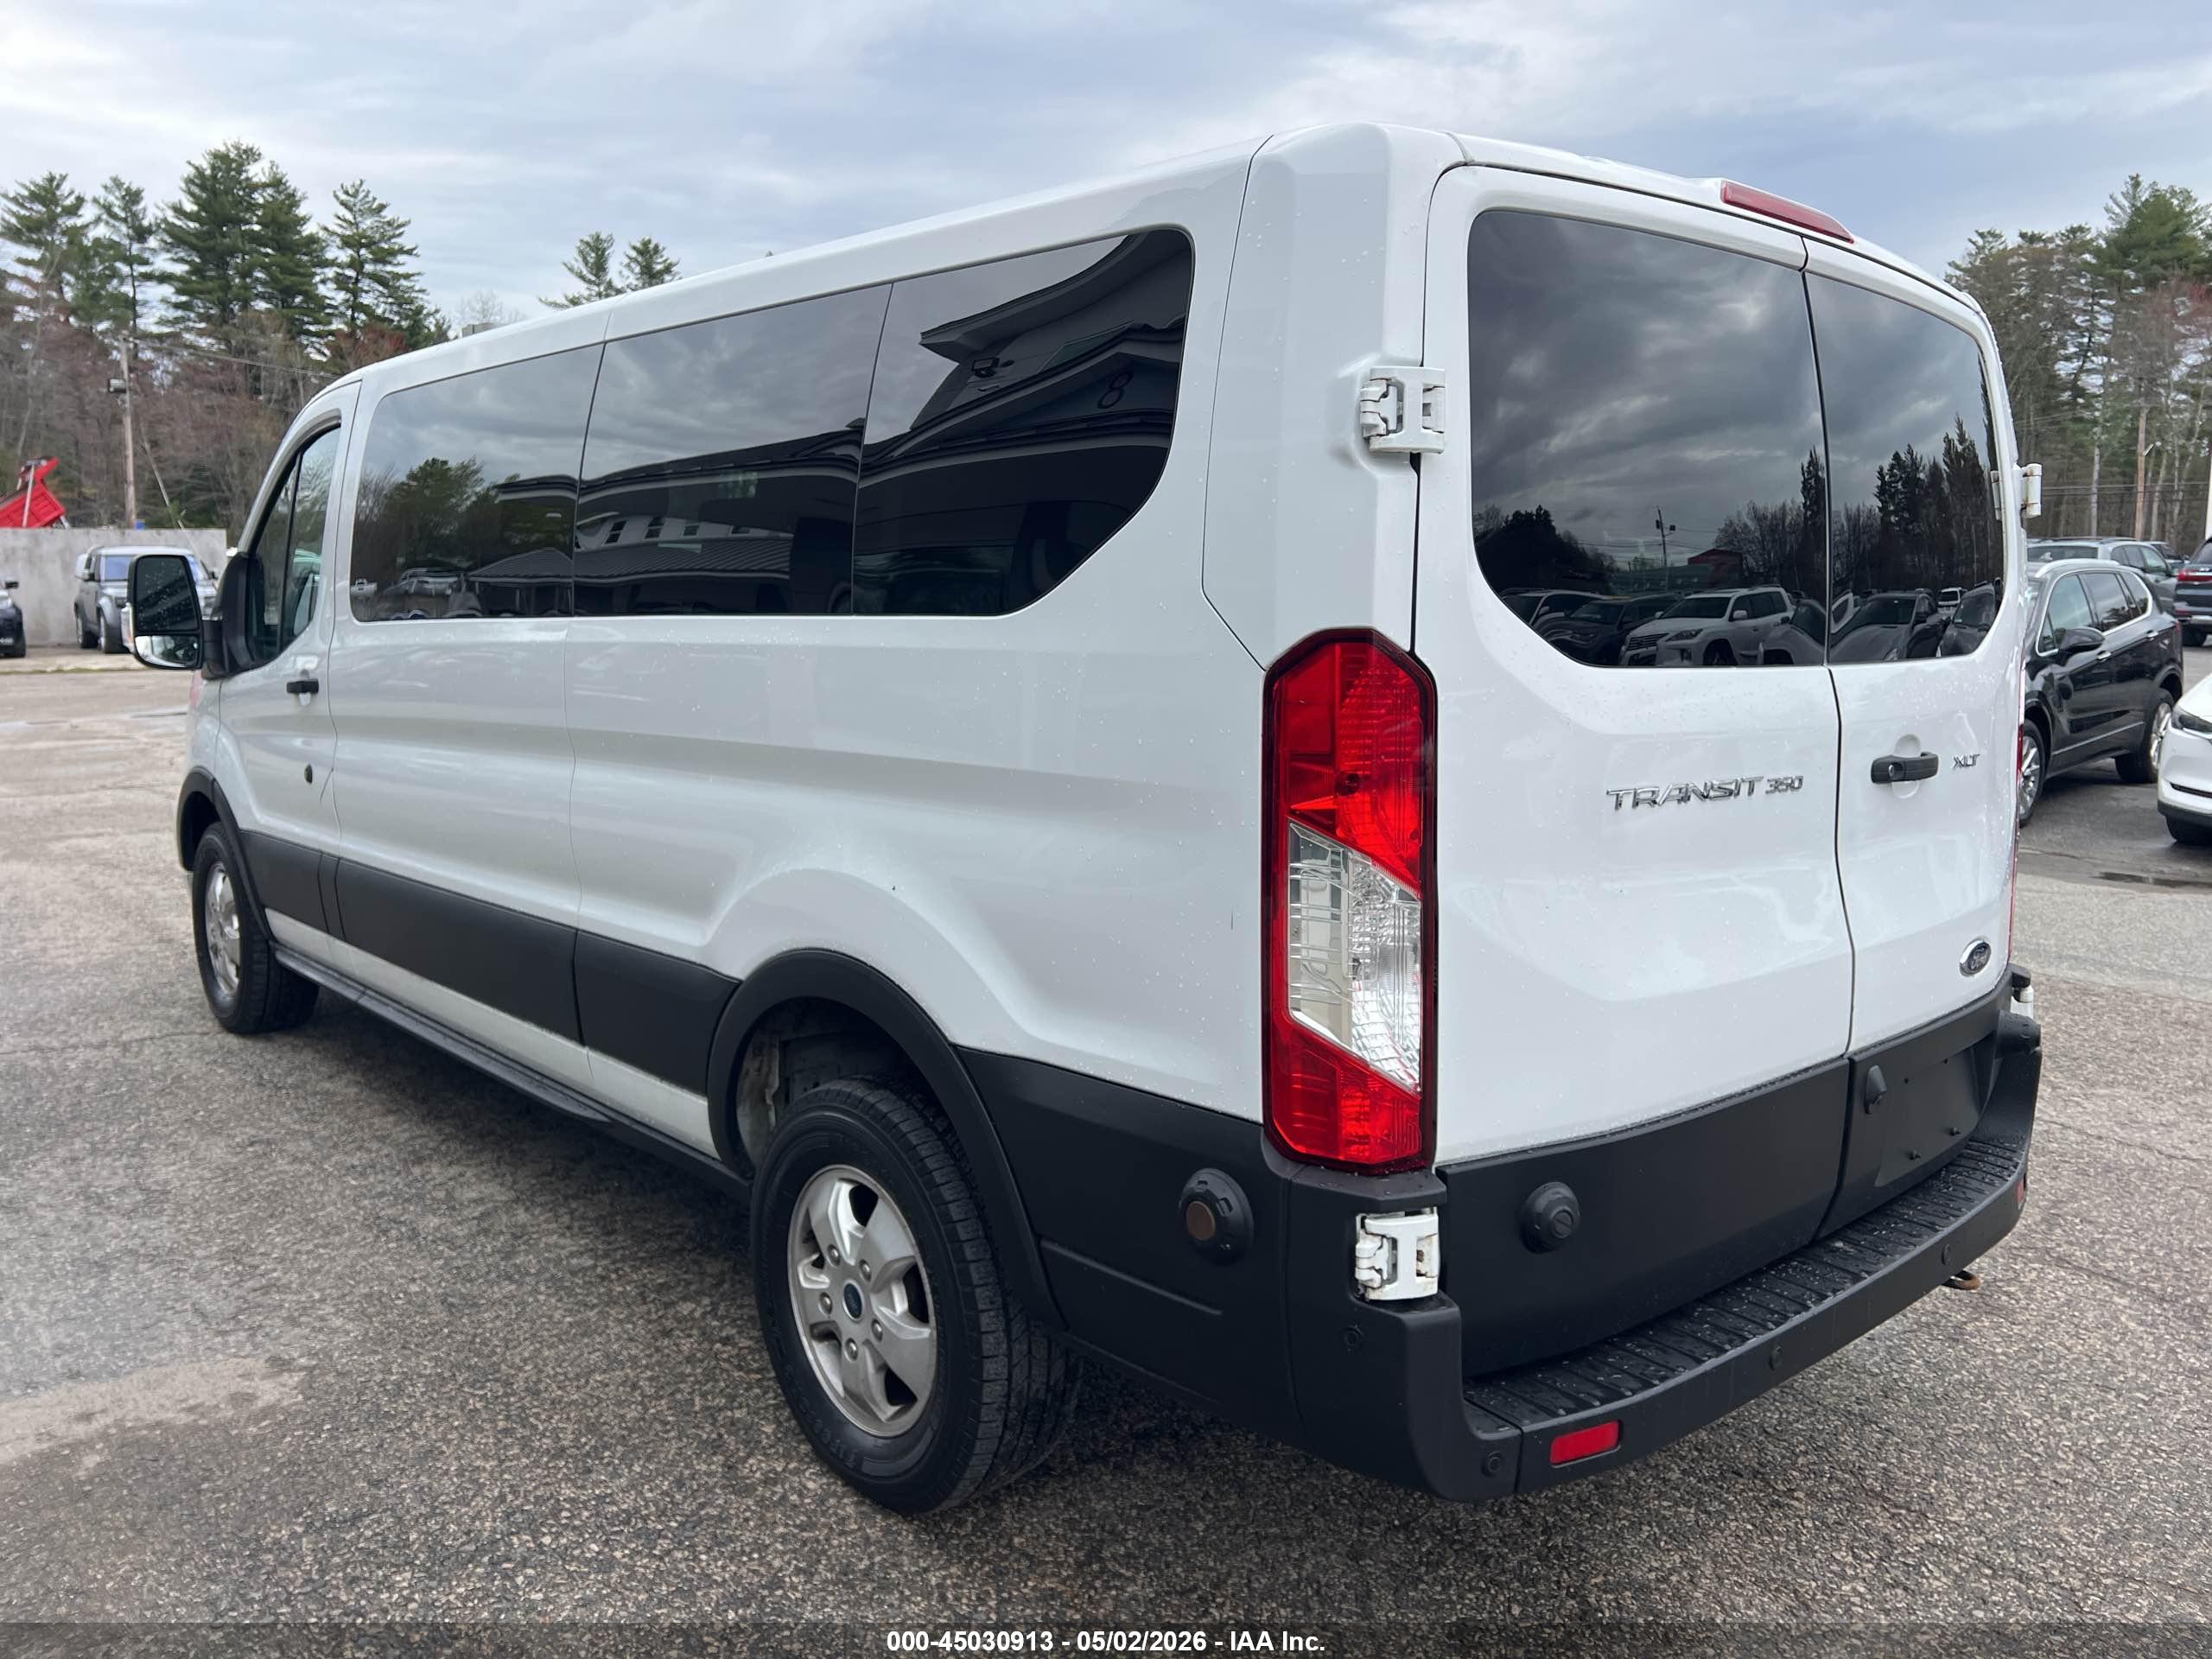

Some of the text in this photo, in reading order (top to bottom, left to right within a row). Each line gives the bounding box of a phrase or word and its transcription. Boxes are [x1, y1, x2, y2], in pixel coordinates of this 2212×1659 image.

[1952, 753, 1980, 769] XLT
[1605, 775, 1804, 811] TRANSIT 350
